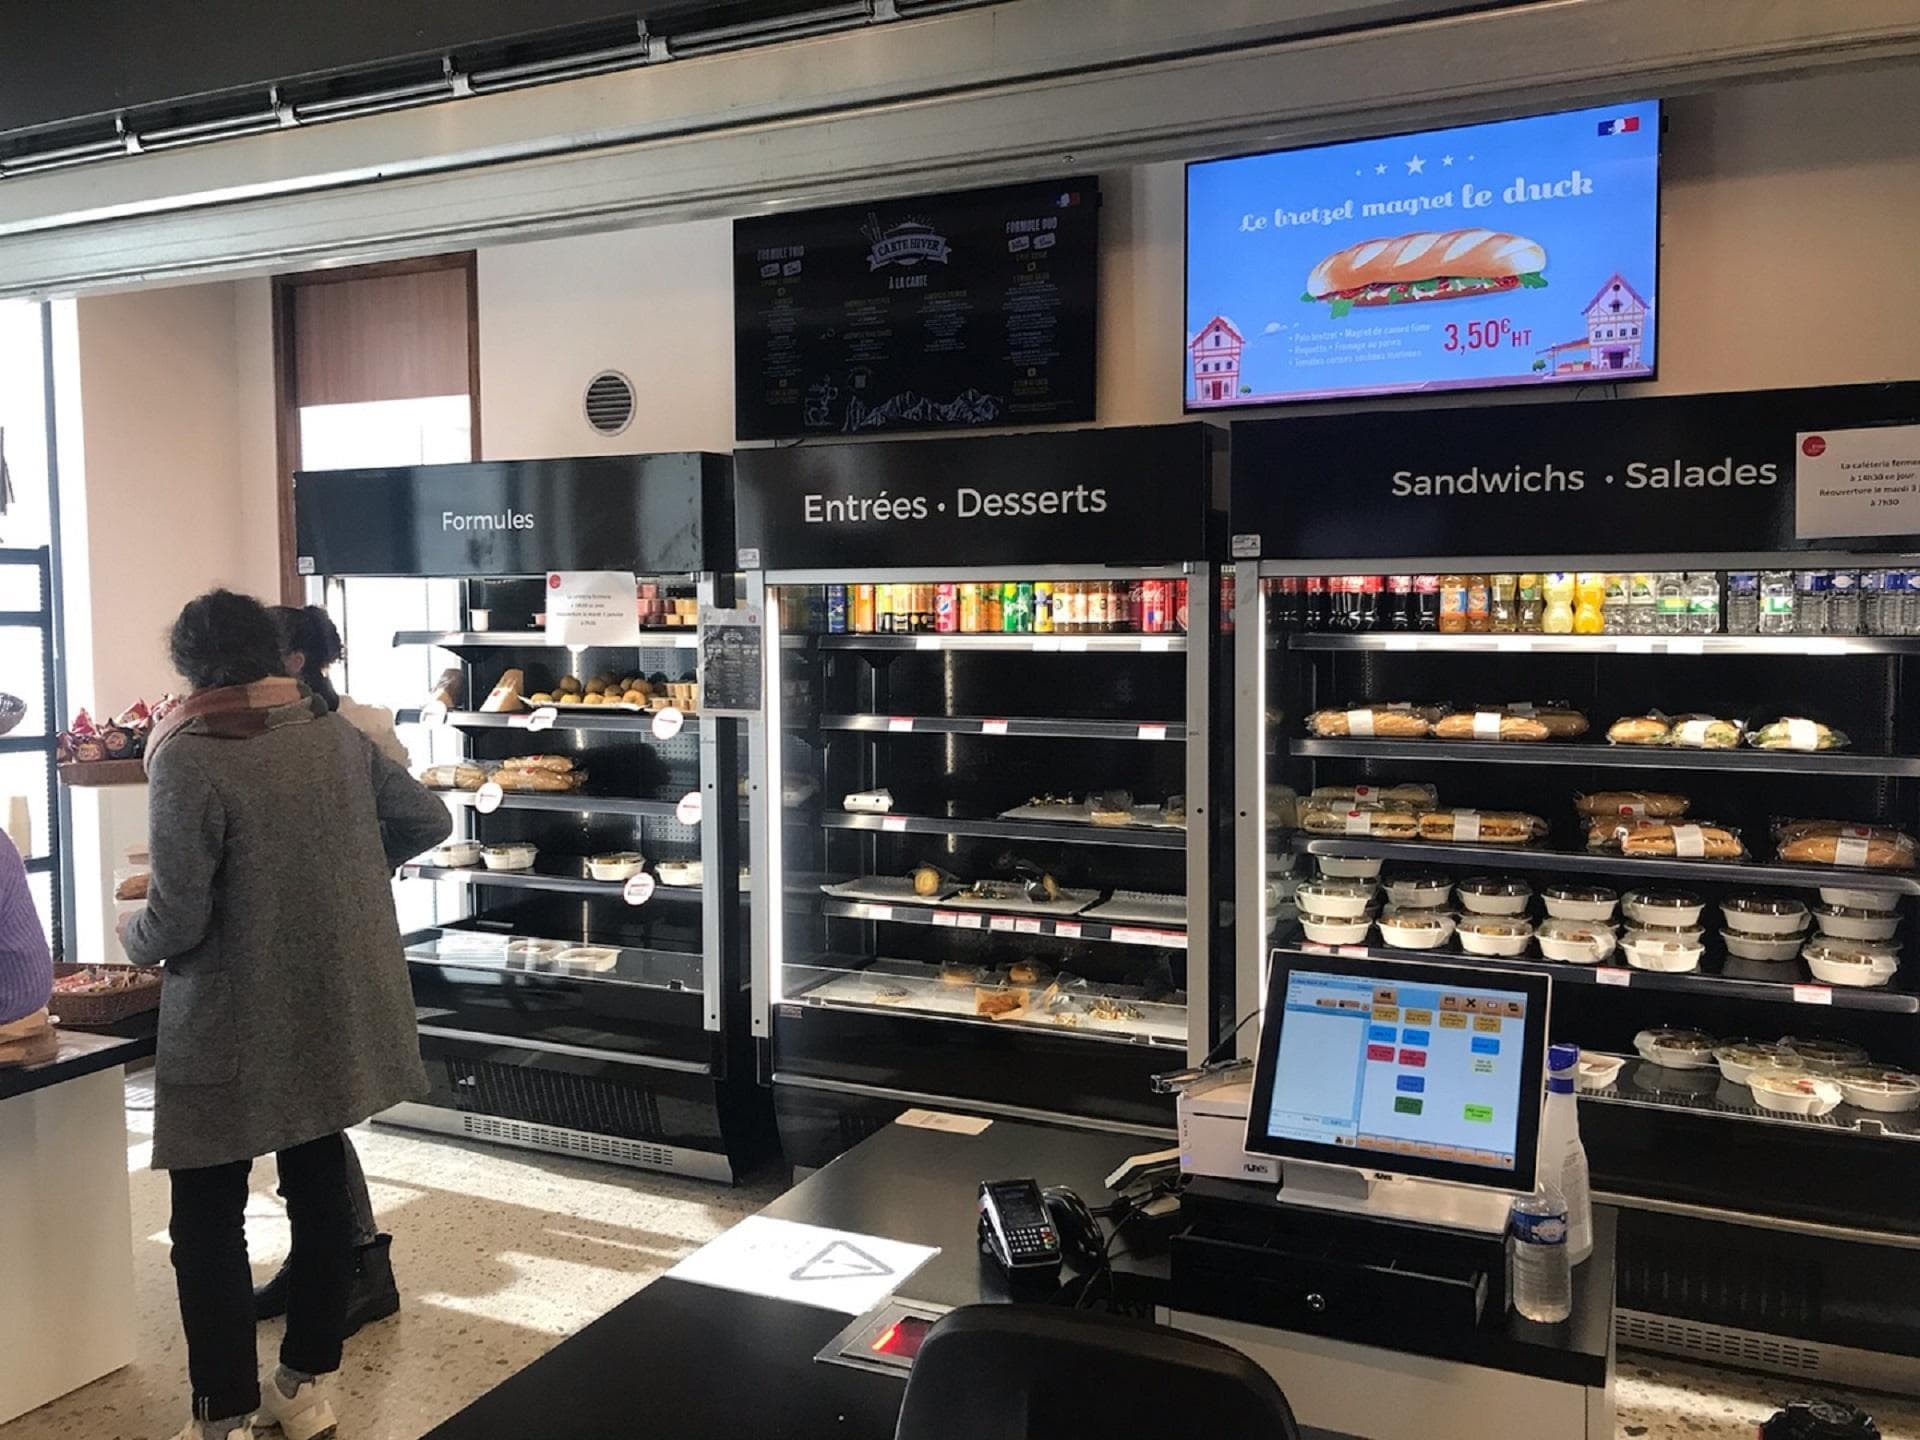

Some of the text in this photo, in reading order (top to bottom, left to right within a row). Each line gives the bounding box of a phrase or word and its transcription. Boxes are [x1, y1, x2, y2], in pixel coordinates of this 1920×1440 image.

[1239, 170, 1593, 232] Le bretzel magret le duck
[1512, 329, 1532, 347] HT
[1391, 457, 1778, 497] Sandwichs Salades
[442, 508, 535, 532] Formules
[804, 484, 1107, 523] Entrées Desserts
